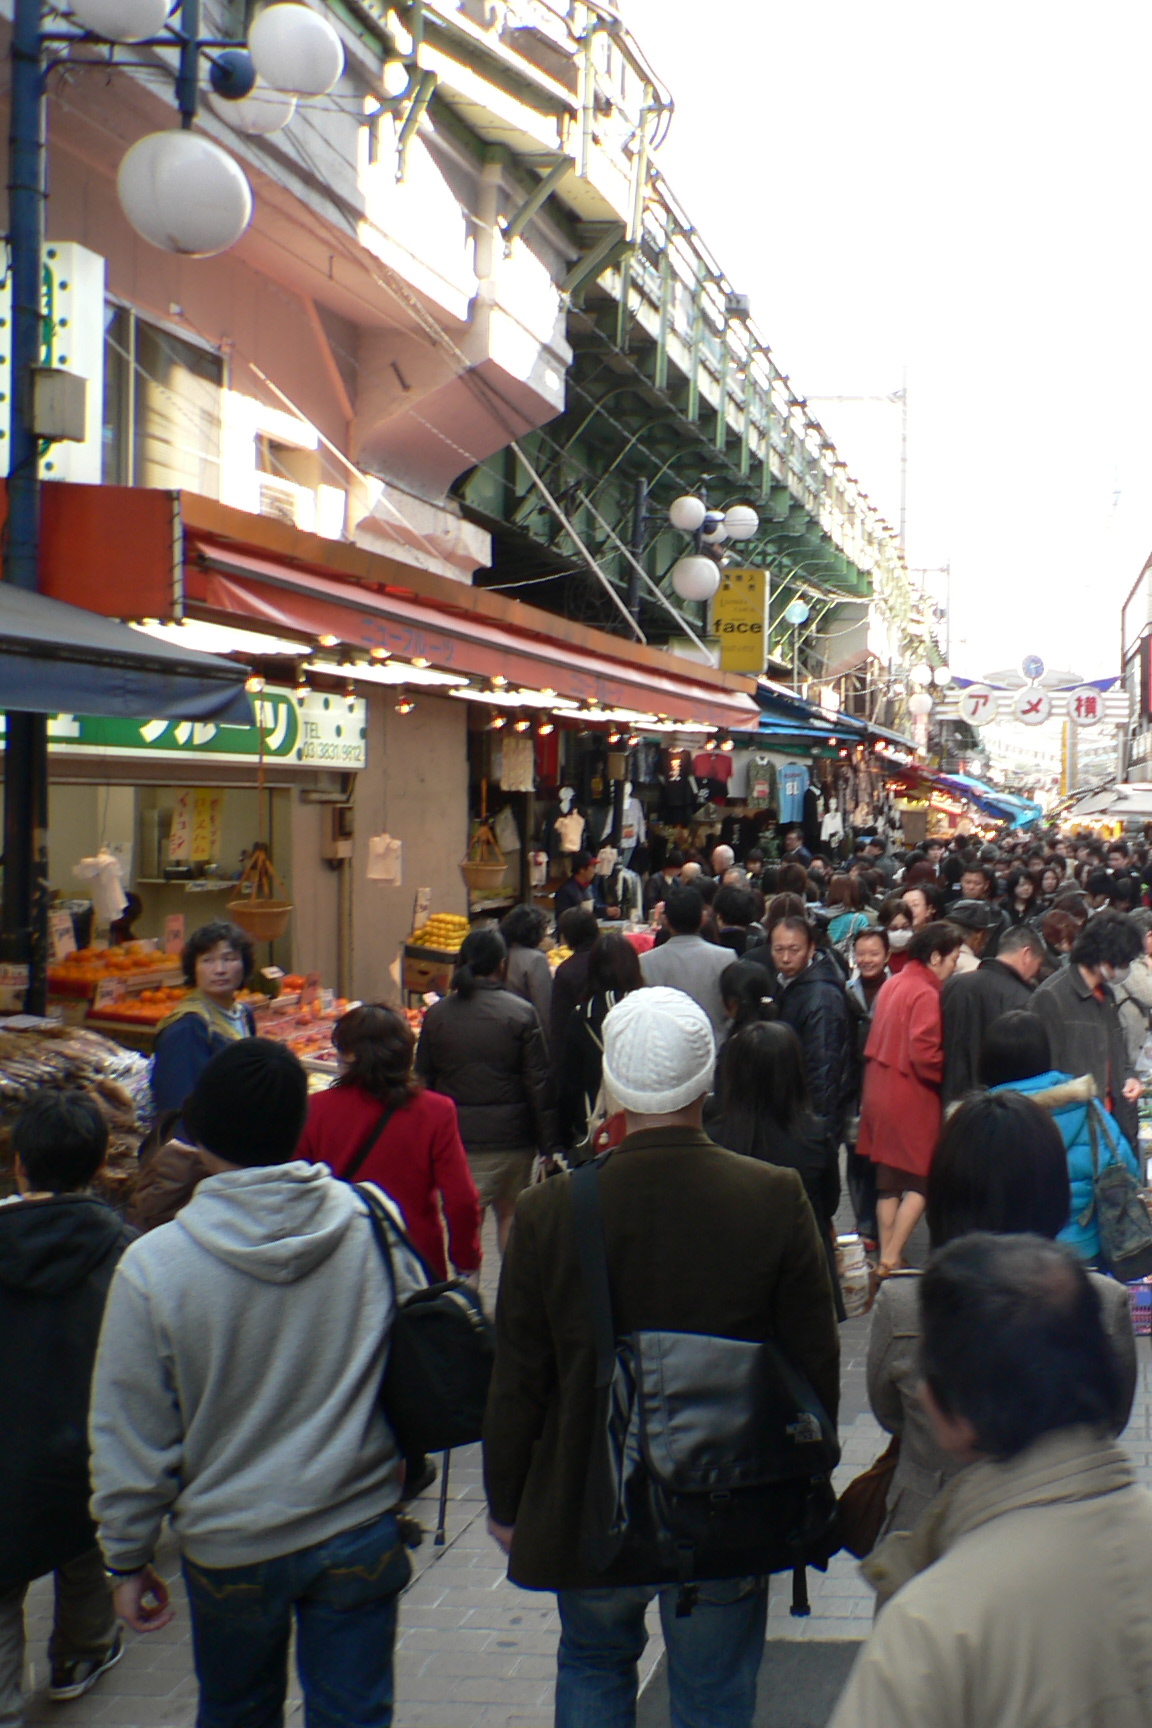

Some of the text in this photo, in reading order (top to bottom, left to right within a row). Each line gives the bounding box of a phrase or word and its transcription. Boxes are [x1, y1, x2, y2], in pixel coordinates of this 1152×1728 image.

[714, 619, 762, 633] face
[361, 617, 455, 663] ニューフルーツ
[969, 694, 1097, 718] アメ横
[303, 721, 321, 738] TEL
